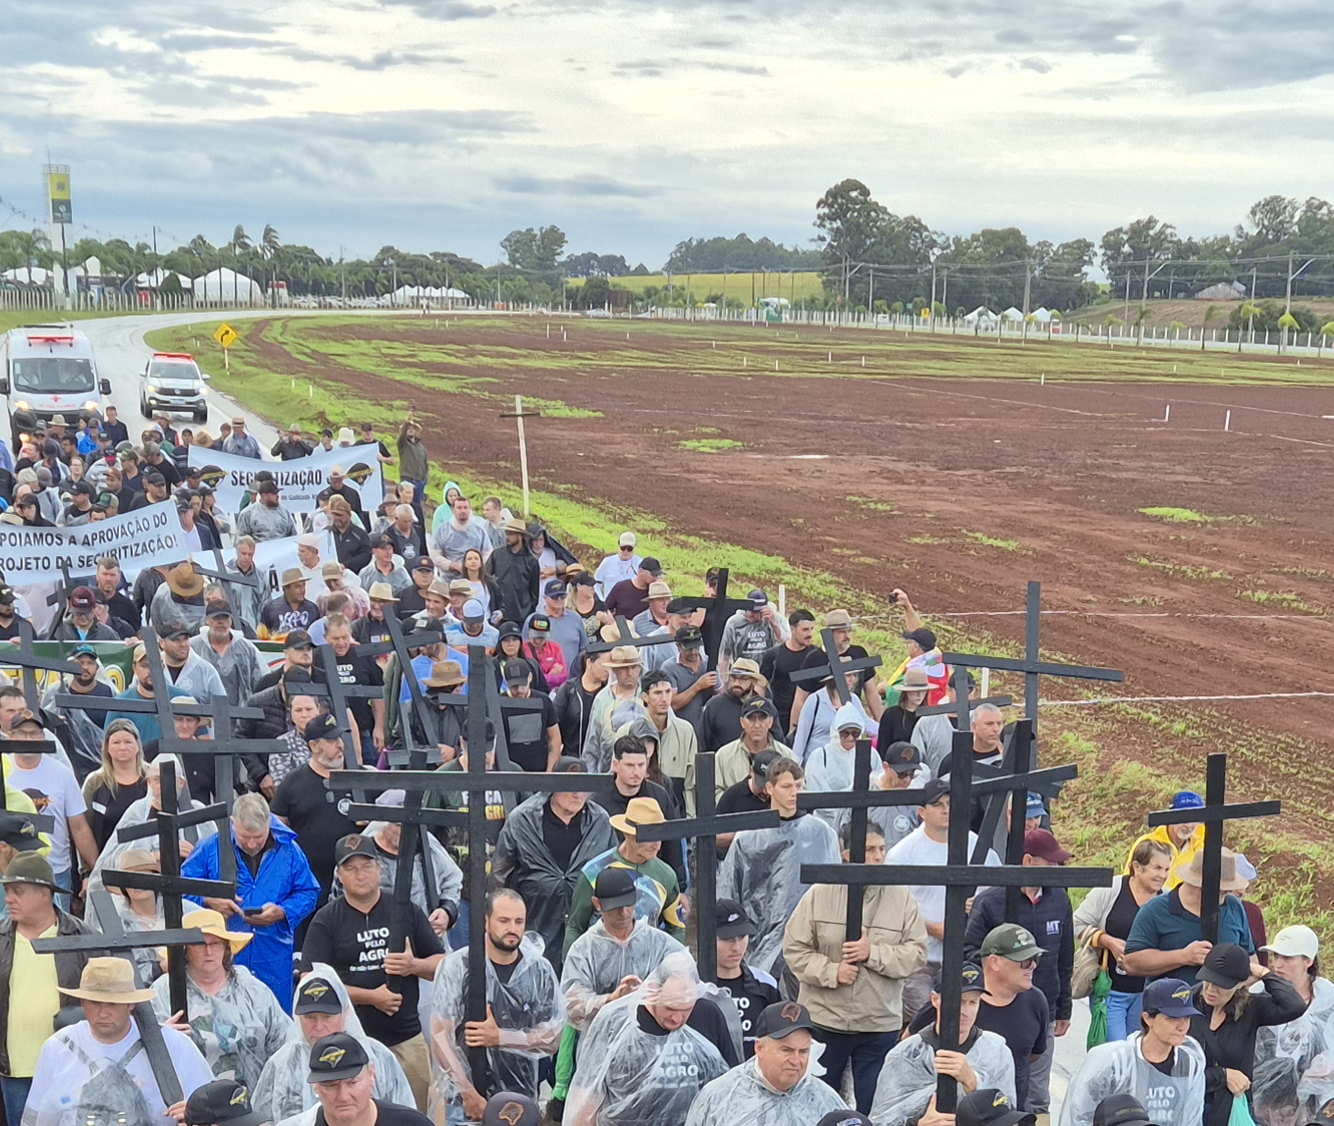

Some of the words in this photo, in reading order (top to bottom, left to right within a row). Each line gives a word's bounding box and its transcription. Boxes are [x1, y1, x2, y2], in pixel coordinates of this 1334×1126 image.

[231, 466, 322, 491] SECTIZAÇÃO
[67, 533, 78, 546] A
[81, 516, 151, 548] APROVAÇÃO
[153, 511, 169, 529] DO
[55, 555, 73, 570] DA
[1046, 920, 1061, 932] MT
[356, 927, 390, 942] LUTO
